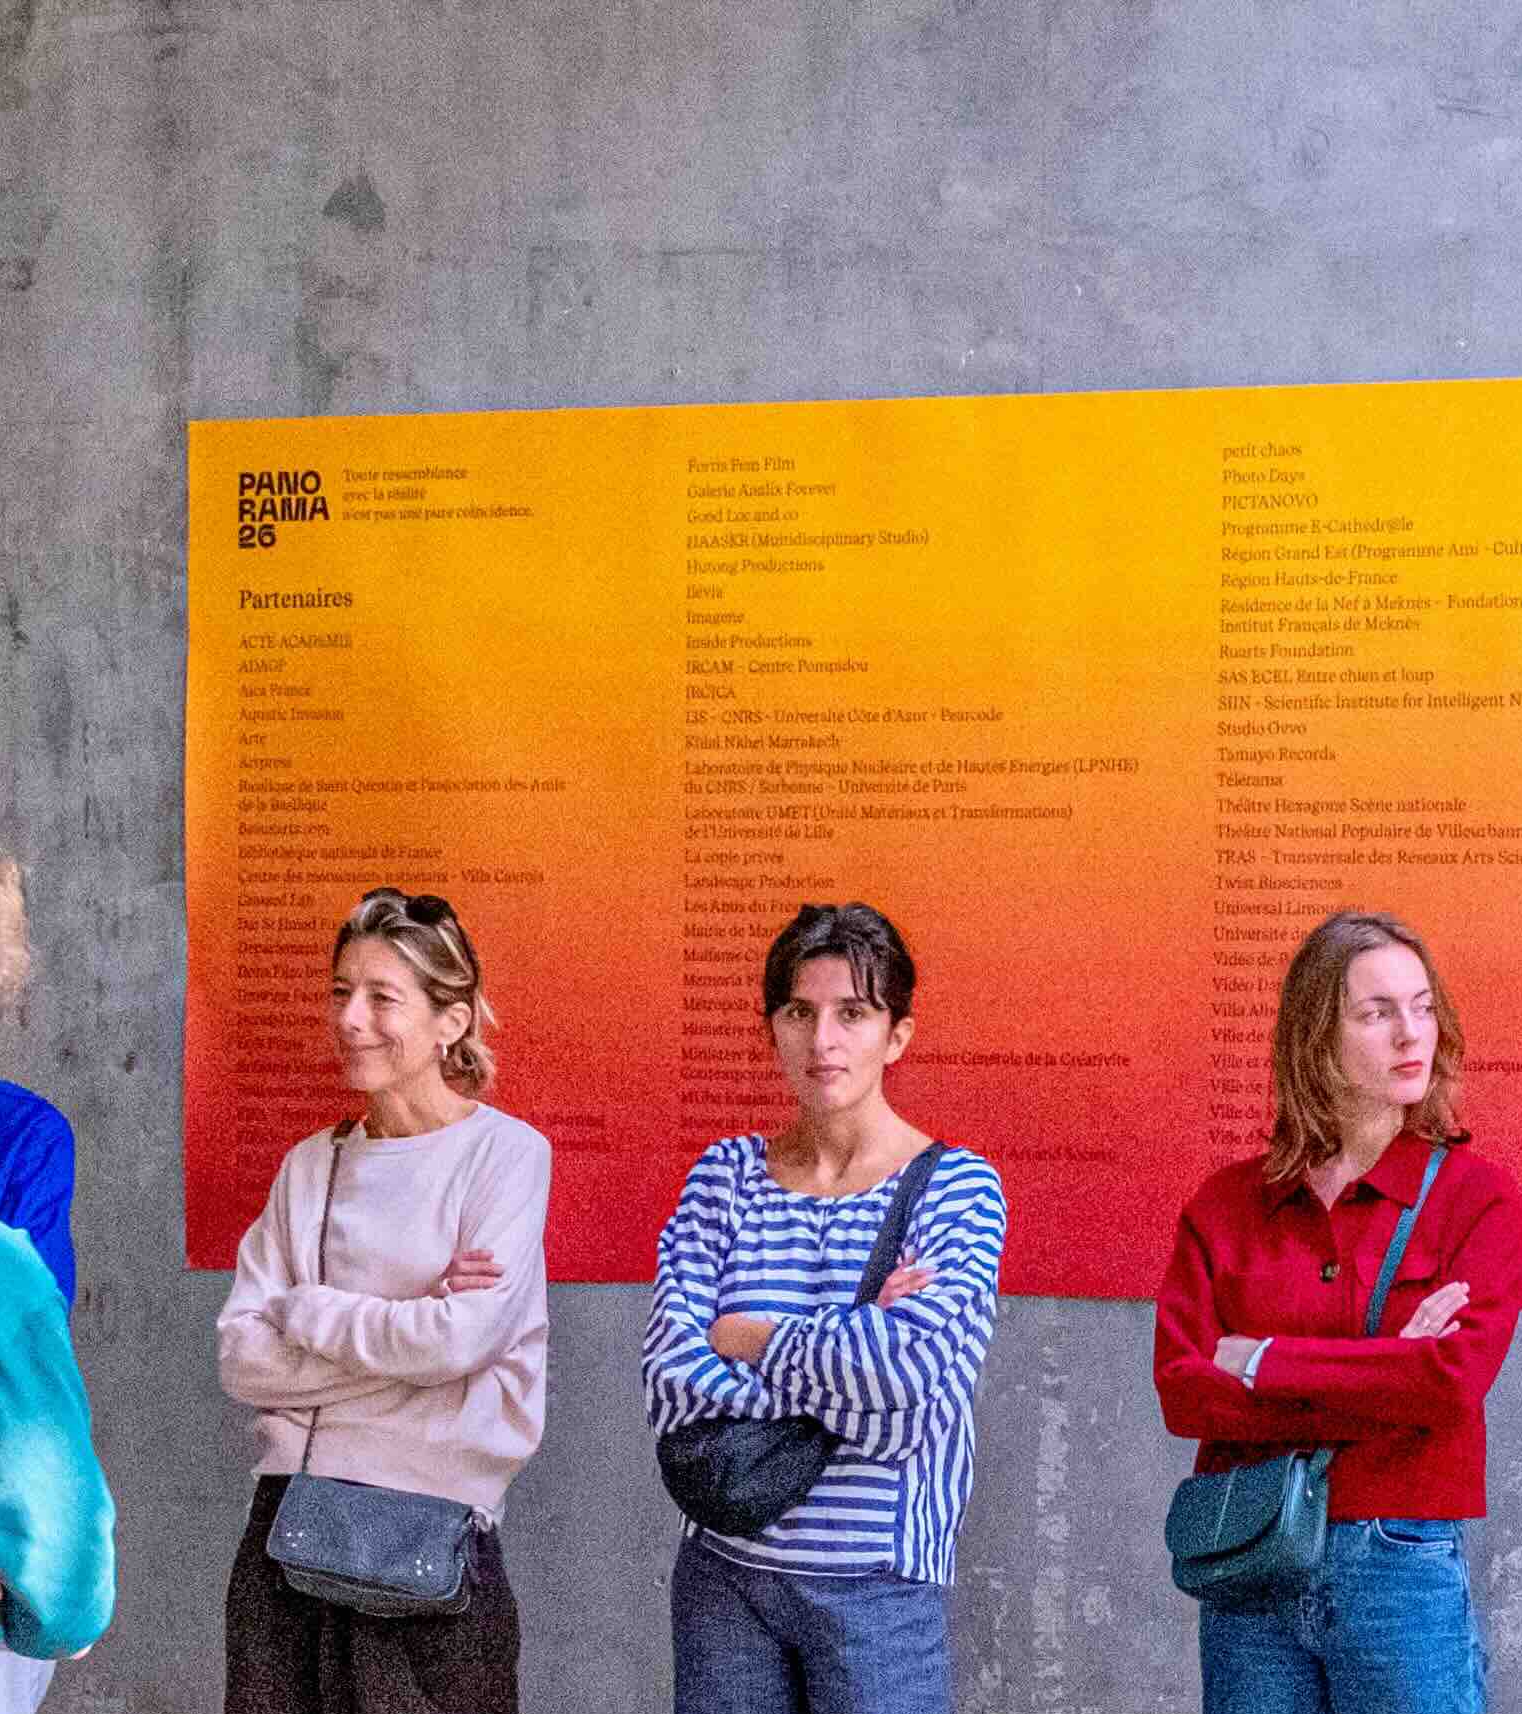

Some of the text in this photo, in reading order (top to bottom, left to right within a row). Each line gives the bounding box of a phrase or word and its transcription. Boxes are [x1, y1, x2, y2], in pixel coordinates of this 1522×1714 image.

[238, 470, 321, 495] PANO
[238, 497, 330, 521] RAMA
[238, 524, 276, 548] 26
[238, 588, 352, 609] Partenaires
